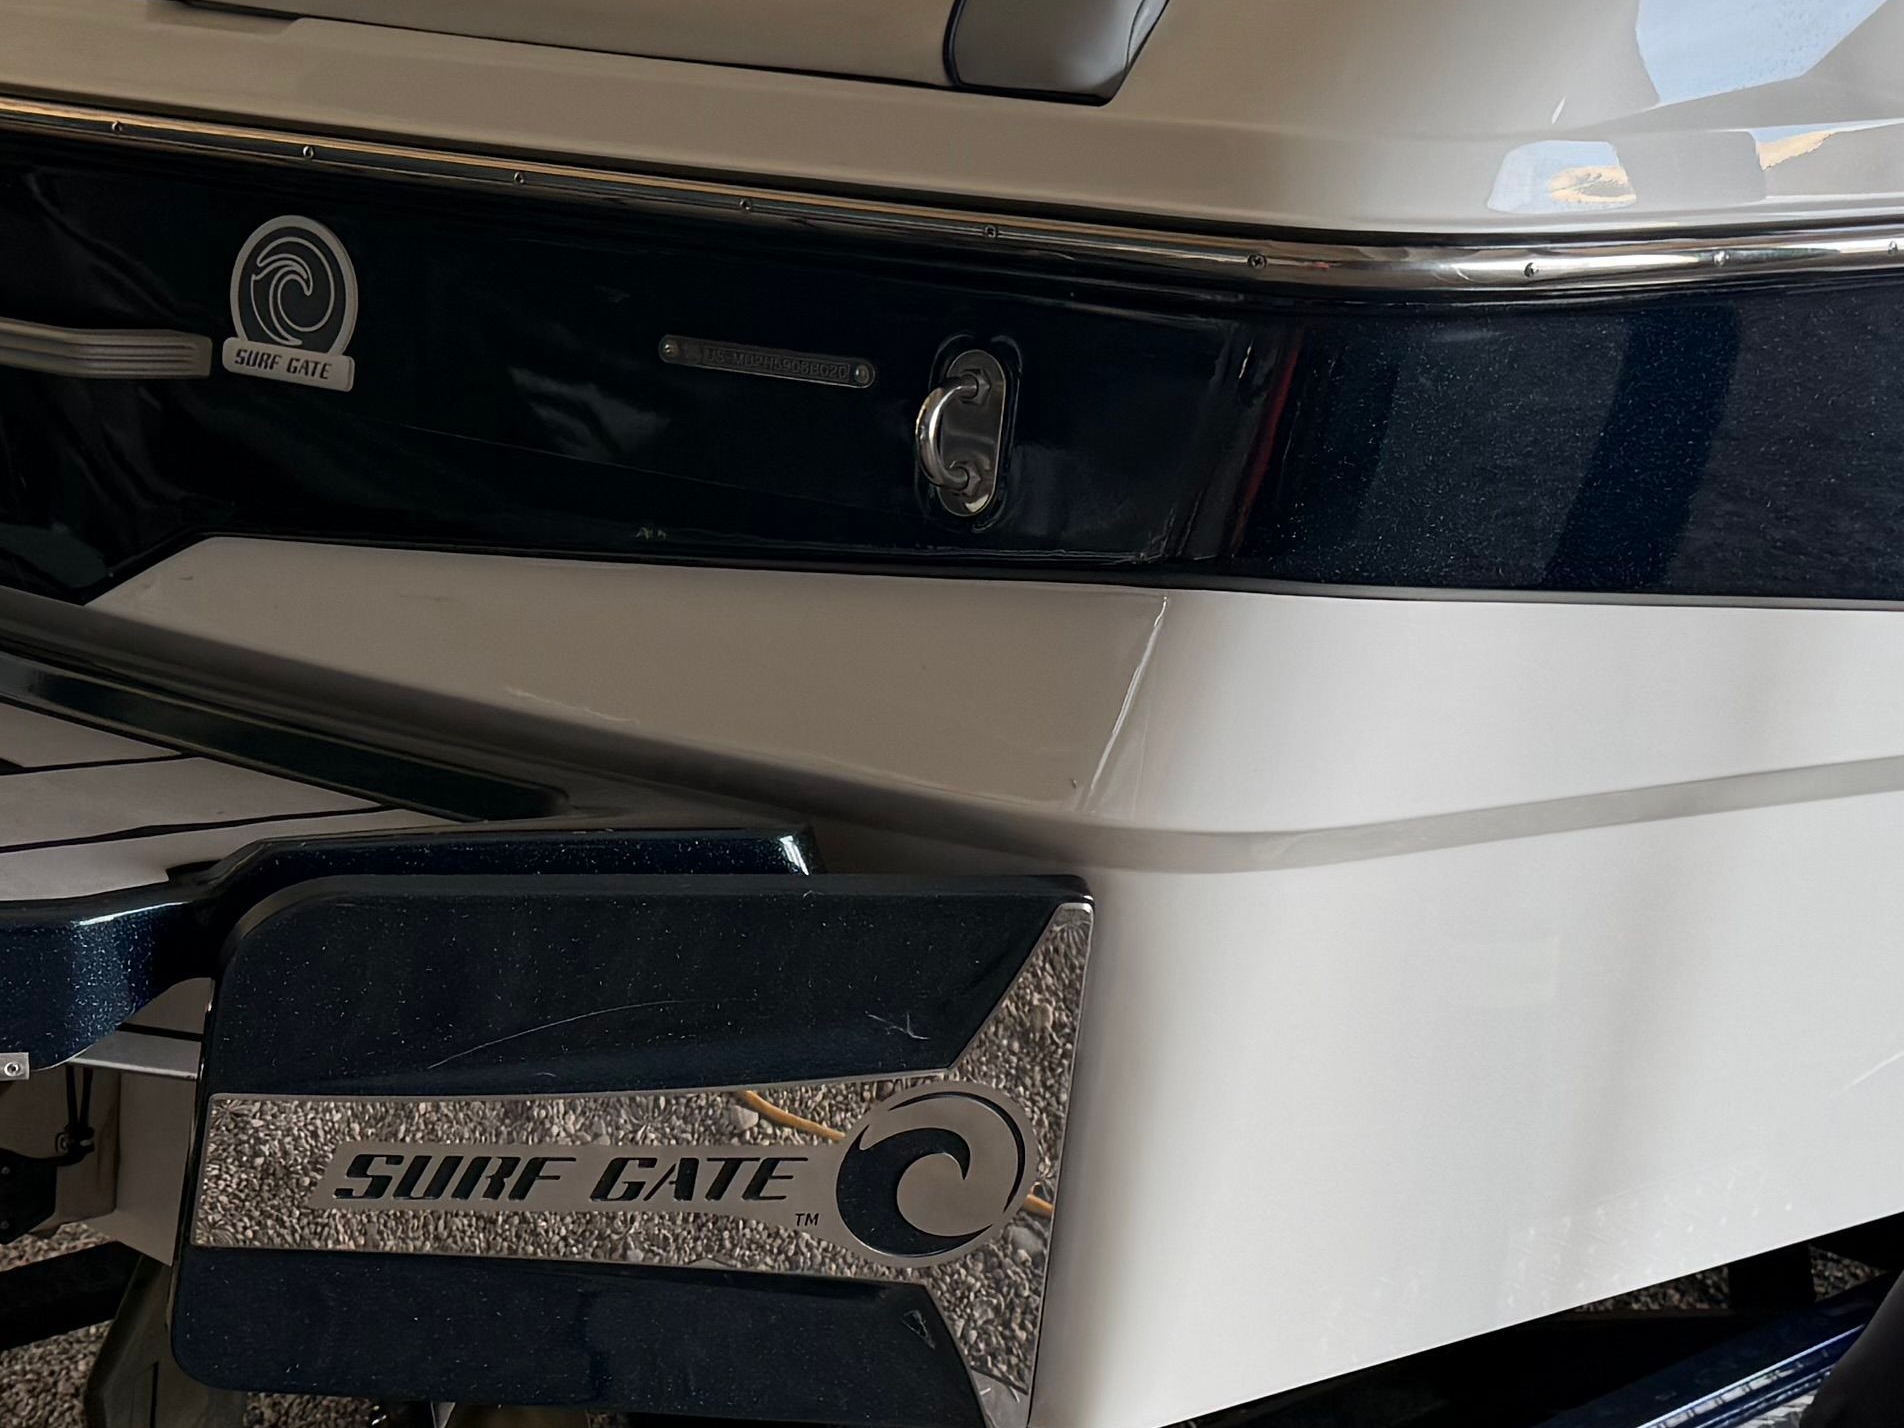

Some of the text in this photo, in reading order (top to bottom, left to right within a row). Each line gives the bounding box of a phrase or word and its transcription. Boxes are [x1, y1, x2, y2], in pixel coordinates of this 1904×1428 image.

[234, 348, 332, 380] SURF GATE
[333, 1153, 808, 1202] SURF GATE
[795, 1213, 820, 1228] TM
